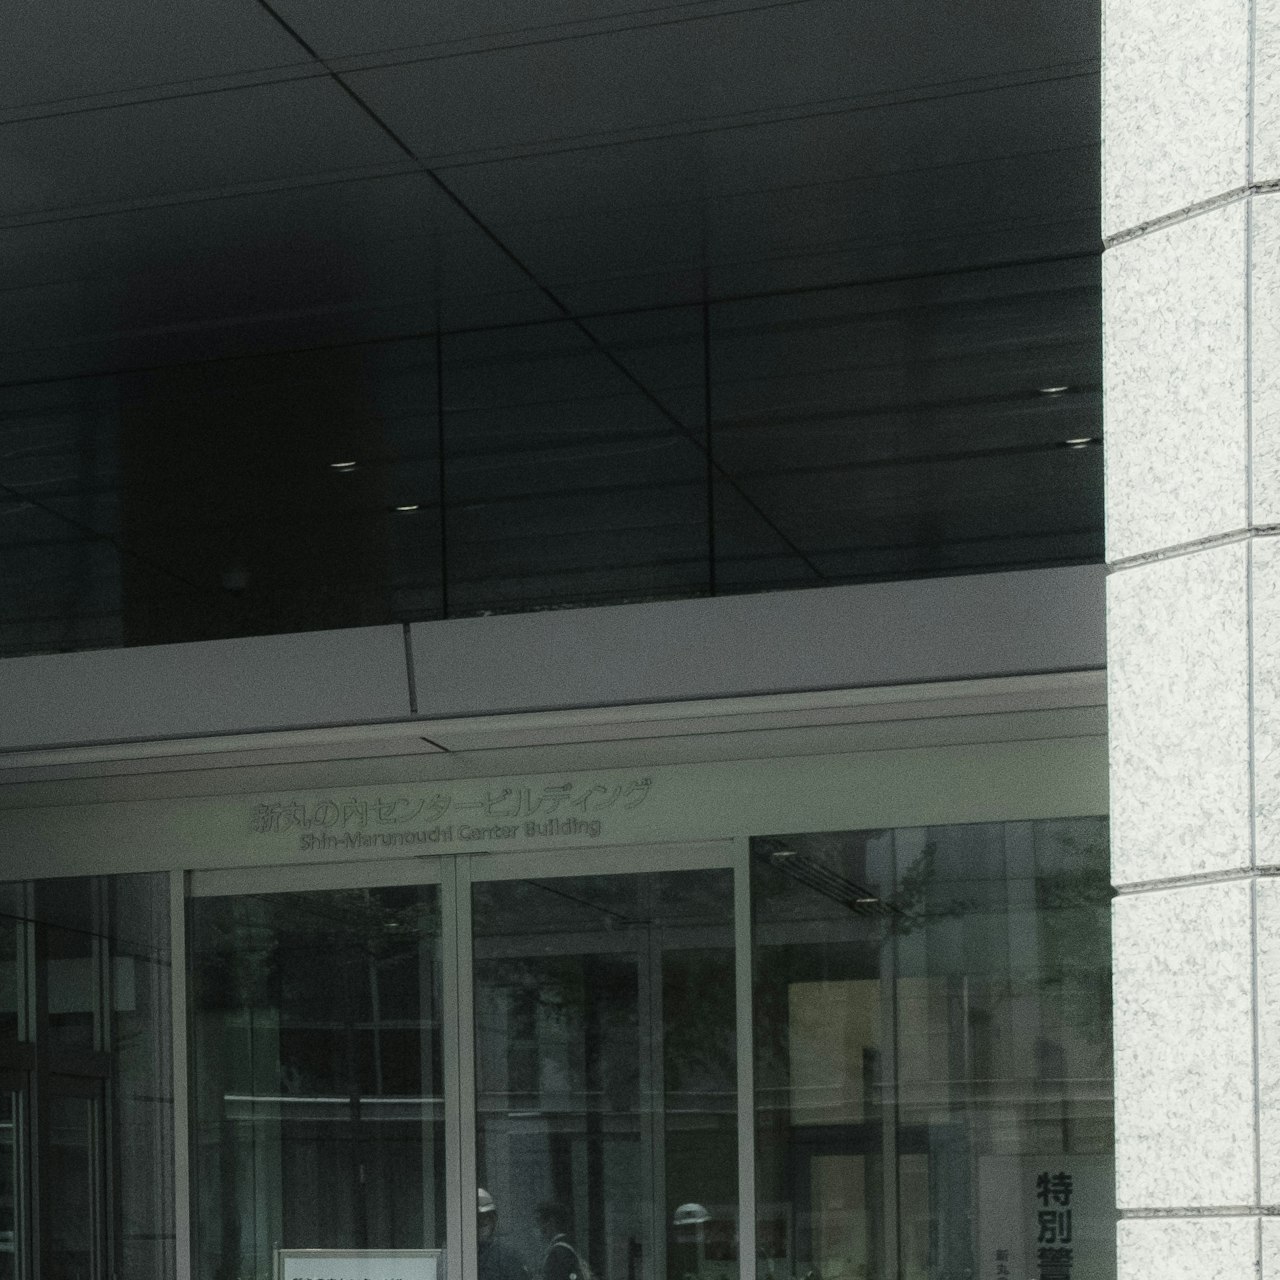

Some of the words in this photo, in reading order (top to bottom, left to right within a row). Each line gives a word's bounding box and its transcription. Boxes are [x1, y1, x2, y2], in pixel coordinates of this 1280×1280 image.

[251, 777, 653, 833] 新丸の内センタービルディング
[301, 825, 453, 850] Shin-Marunouchi
[458, 824, 519, 840] Center
[525, 817, 602, 838] Building
